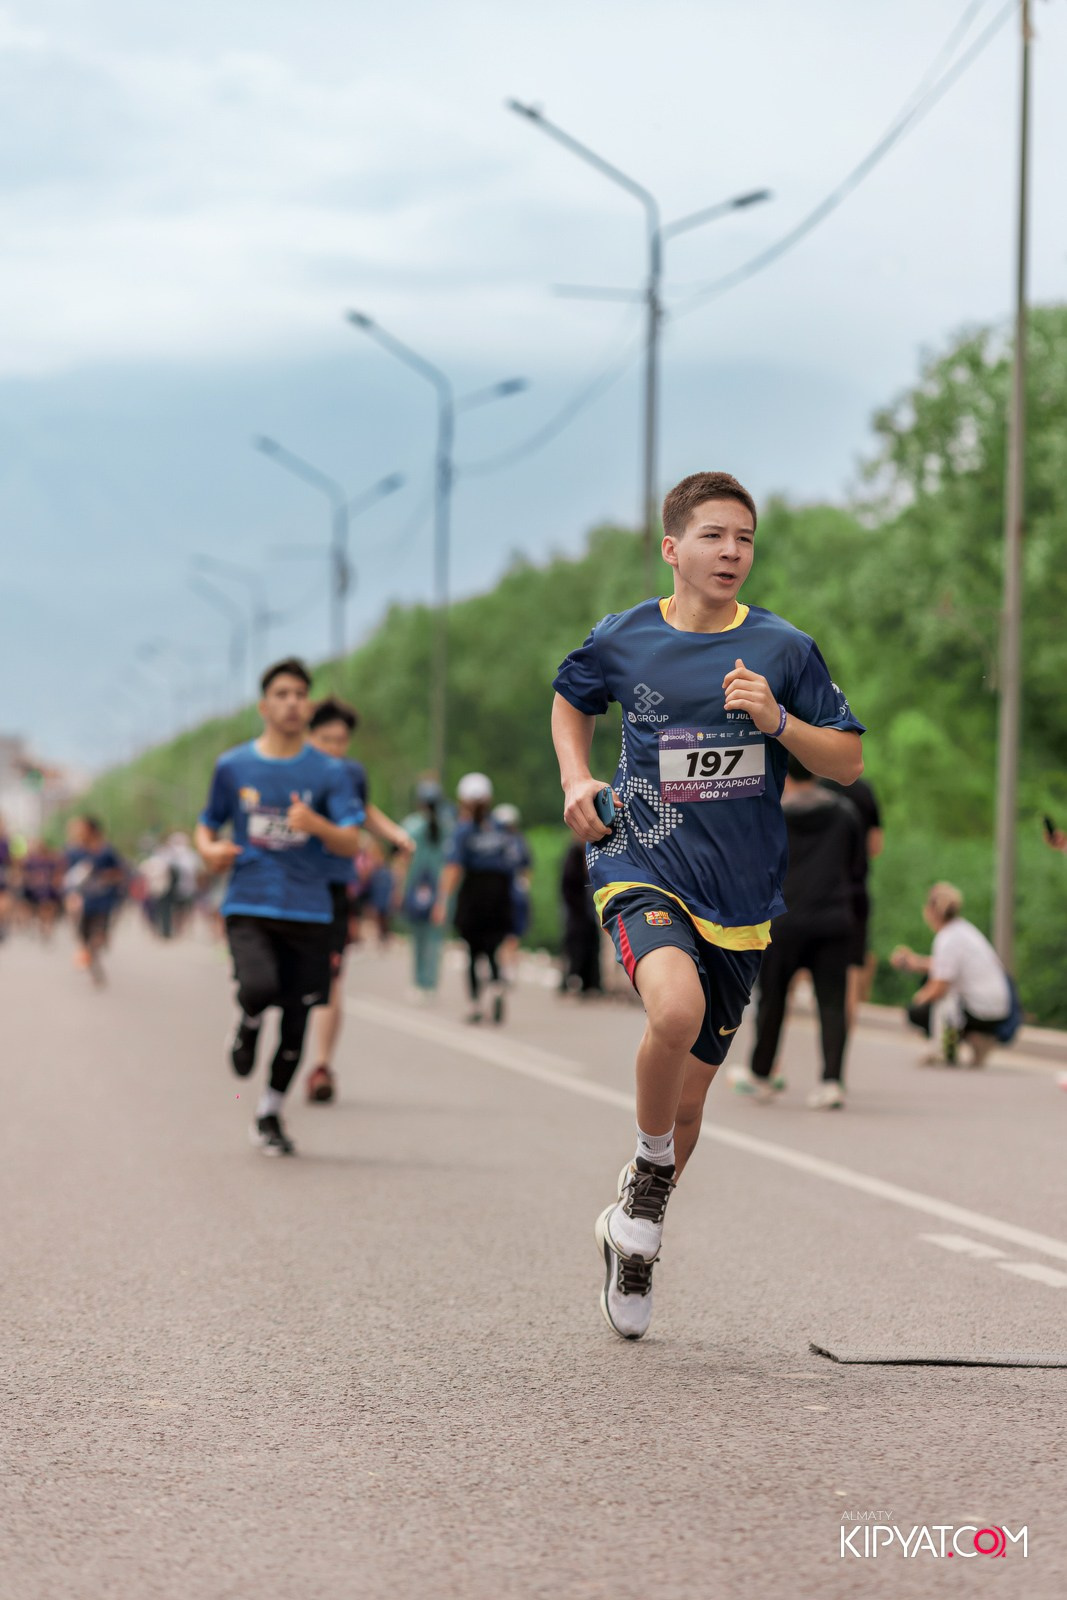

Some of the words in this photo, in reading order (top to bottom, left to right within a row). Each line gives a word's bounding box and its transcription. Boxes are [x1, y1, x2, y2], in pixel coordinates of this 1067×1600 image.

[686, 750, 744, 777] 197
[665, 782, 712, 791] БАЛАЛАР
[715, 777, 760, 788] ЖАРЫСЫ
[700, 791, 719, 799] 600
